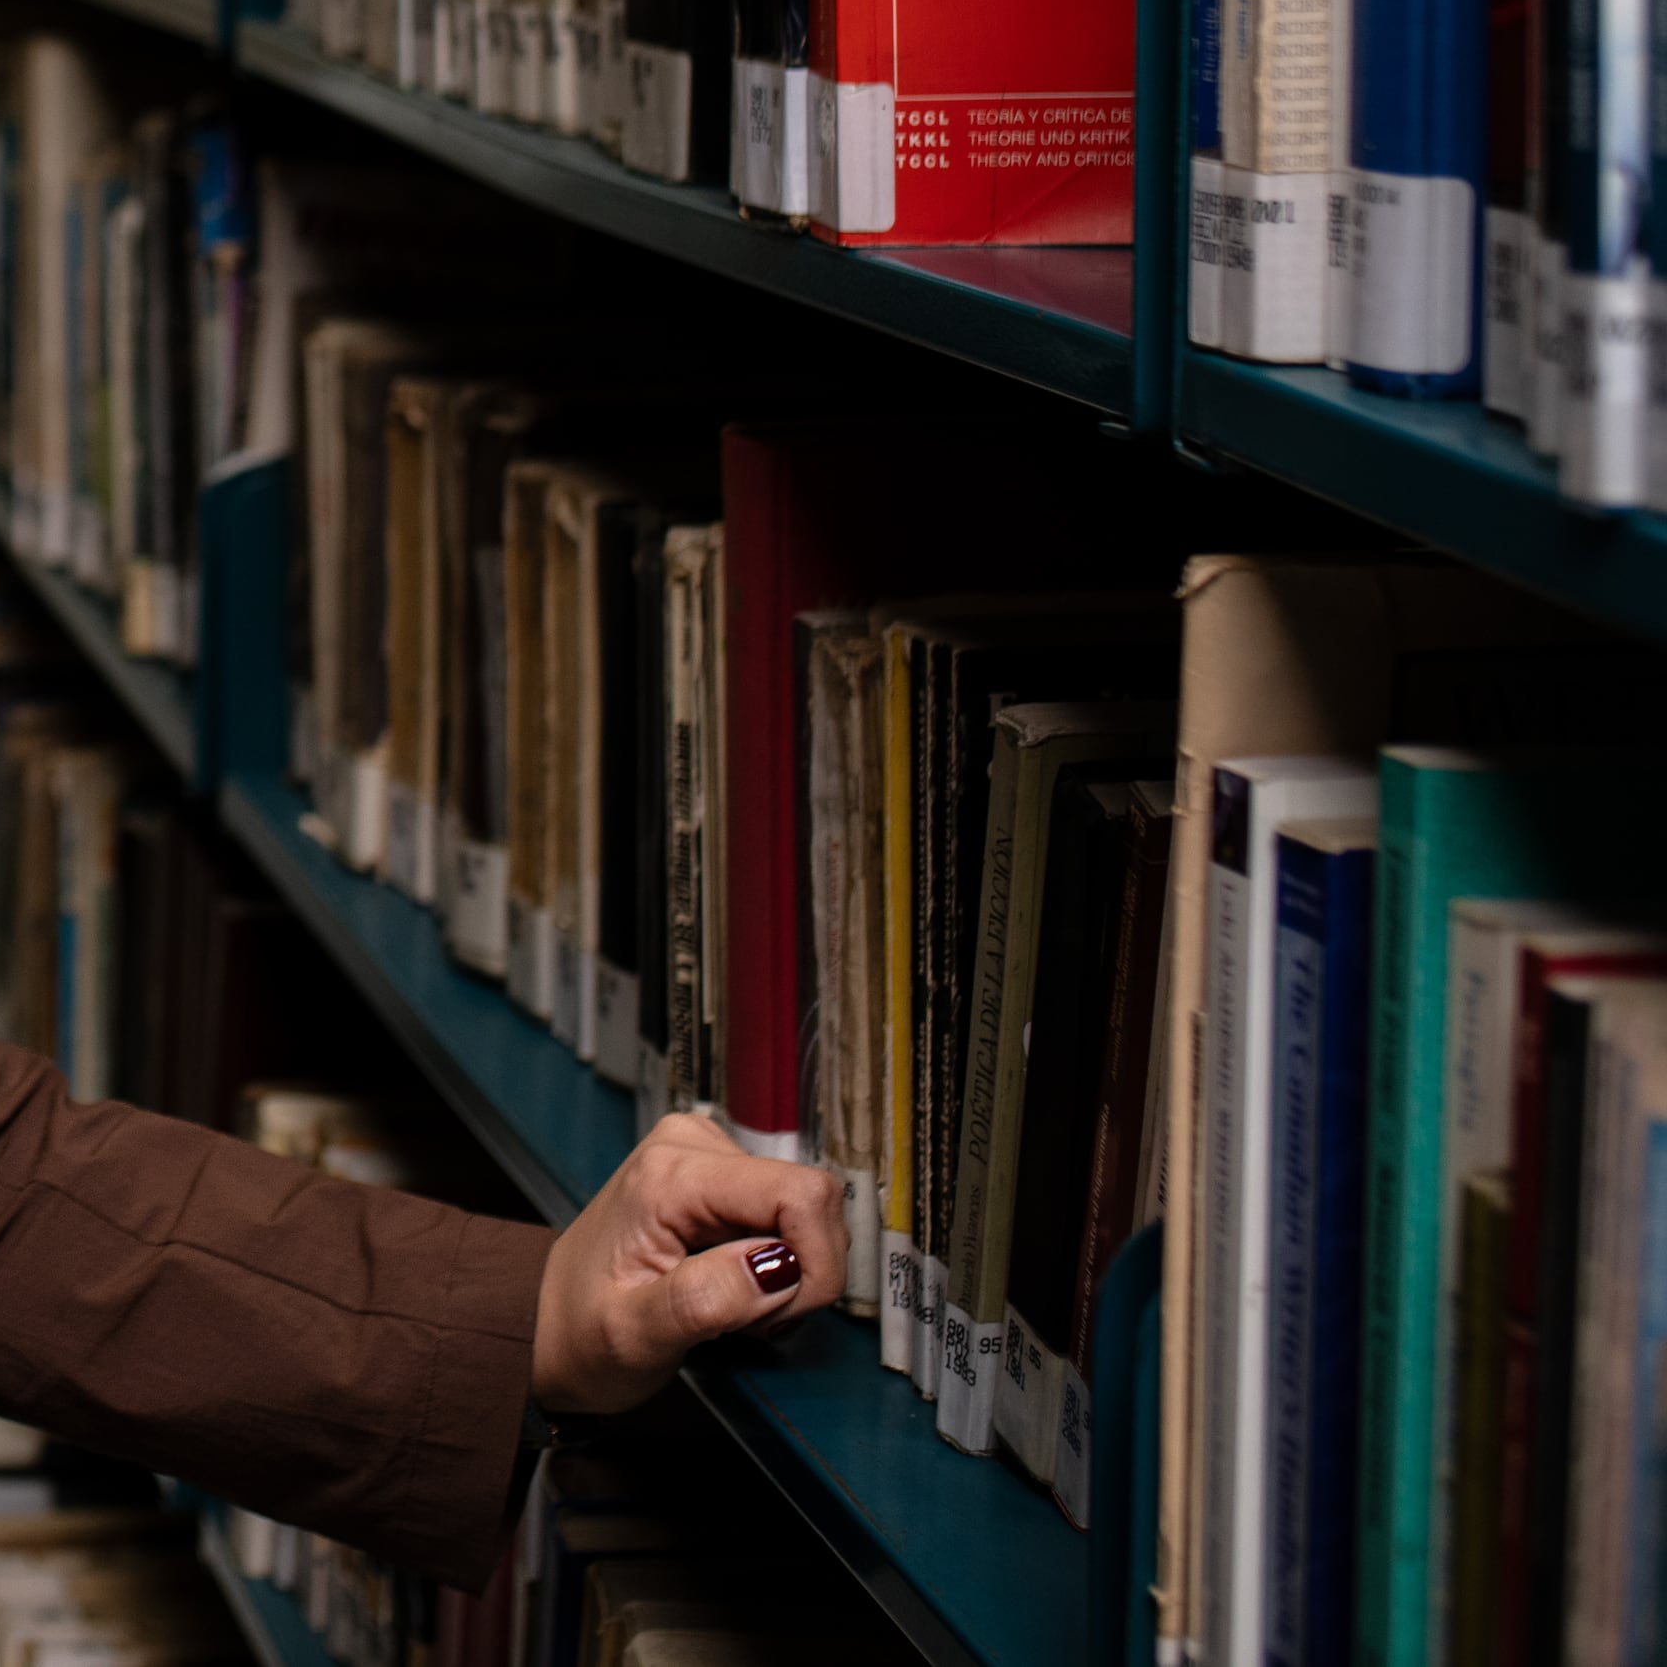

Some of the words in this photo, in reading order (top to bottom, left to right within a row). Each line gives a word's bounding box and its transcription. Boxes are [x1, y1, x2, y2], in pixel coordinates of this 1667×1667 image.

[968, 106, 1024, 125] TEORÍA
[1028, 109, 1039, 124] Y
[1043, 107, 1107, 125] CRÍTICA
[1110, 108, 1133, 124] DE
[968, 130, 1036, 148] THEORIE
[1040, 129, 1076, 146] UND
[1079, 128, 1131, 146] KRITIK
[968, 152, 1032, 169] THEORY
[1036, 151, 1071, 168] AND
[1074, 150, 1135, 168] CRITICIS
[986, 825, 1013, 948] FICCIÓN
[985, 950, 1005, 985] LA
[1289, 956, 1316, 1032] The
[979, 987, 1002, 1033] DE
[968, 1034, 998, 1166] POÉTICA
[1284, 1045, 1315, 1245] Canadian
[1075, 1296, 1091, 1374] teraturas
[1087, 1227, 1098, 1267] texto
